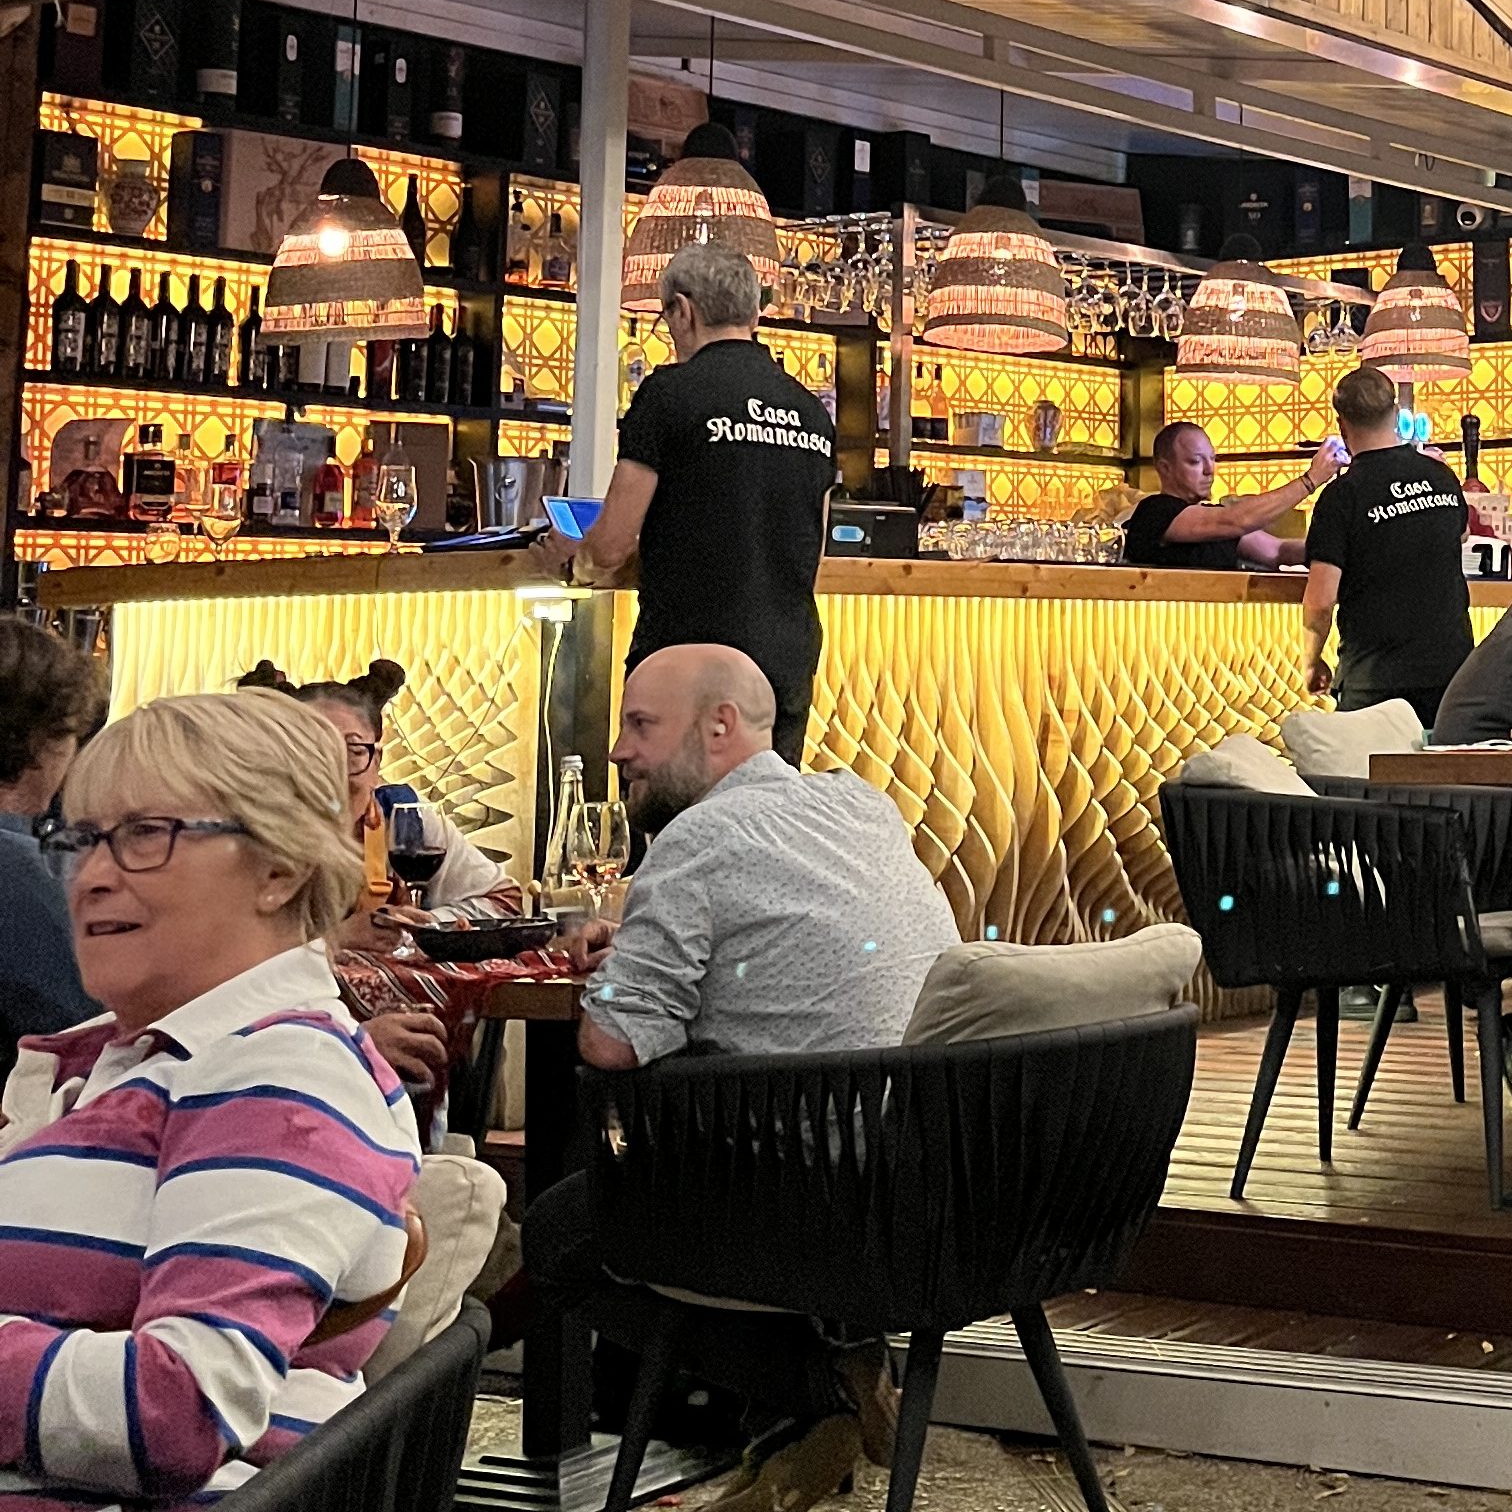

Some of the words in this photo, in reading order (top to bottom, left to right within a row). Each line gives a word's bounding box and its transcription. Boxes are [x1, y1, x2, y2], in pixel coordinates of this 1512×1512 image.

[747, 397, 802, 427] Casa
[1389, 480, 1433, 499] Casa
[1367, 493, 1459, 524] Romaneasca
